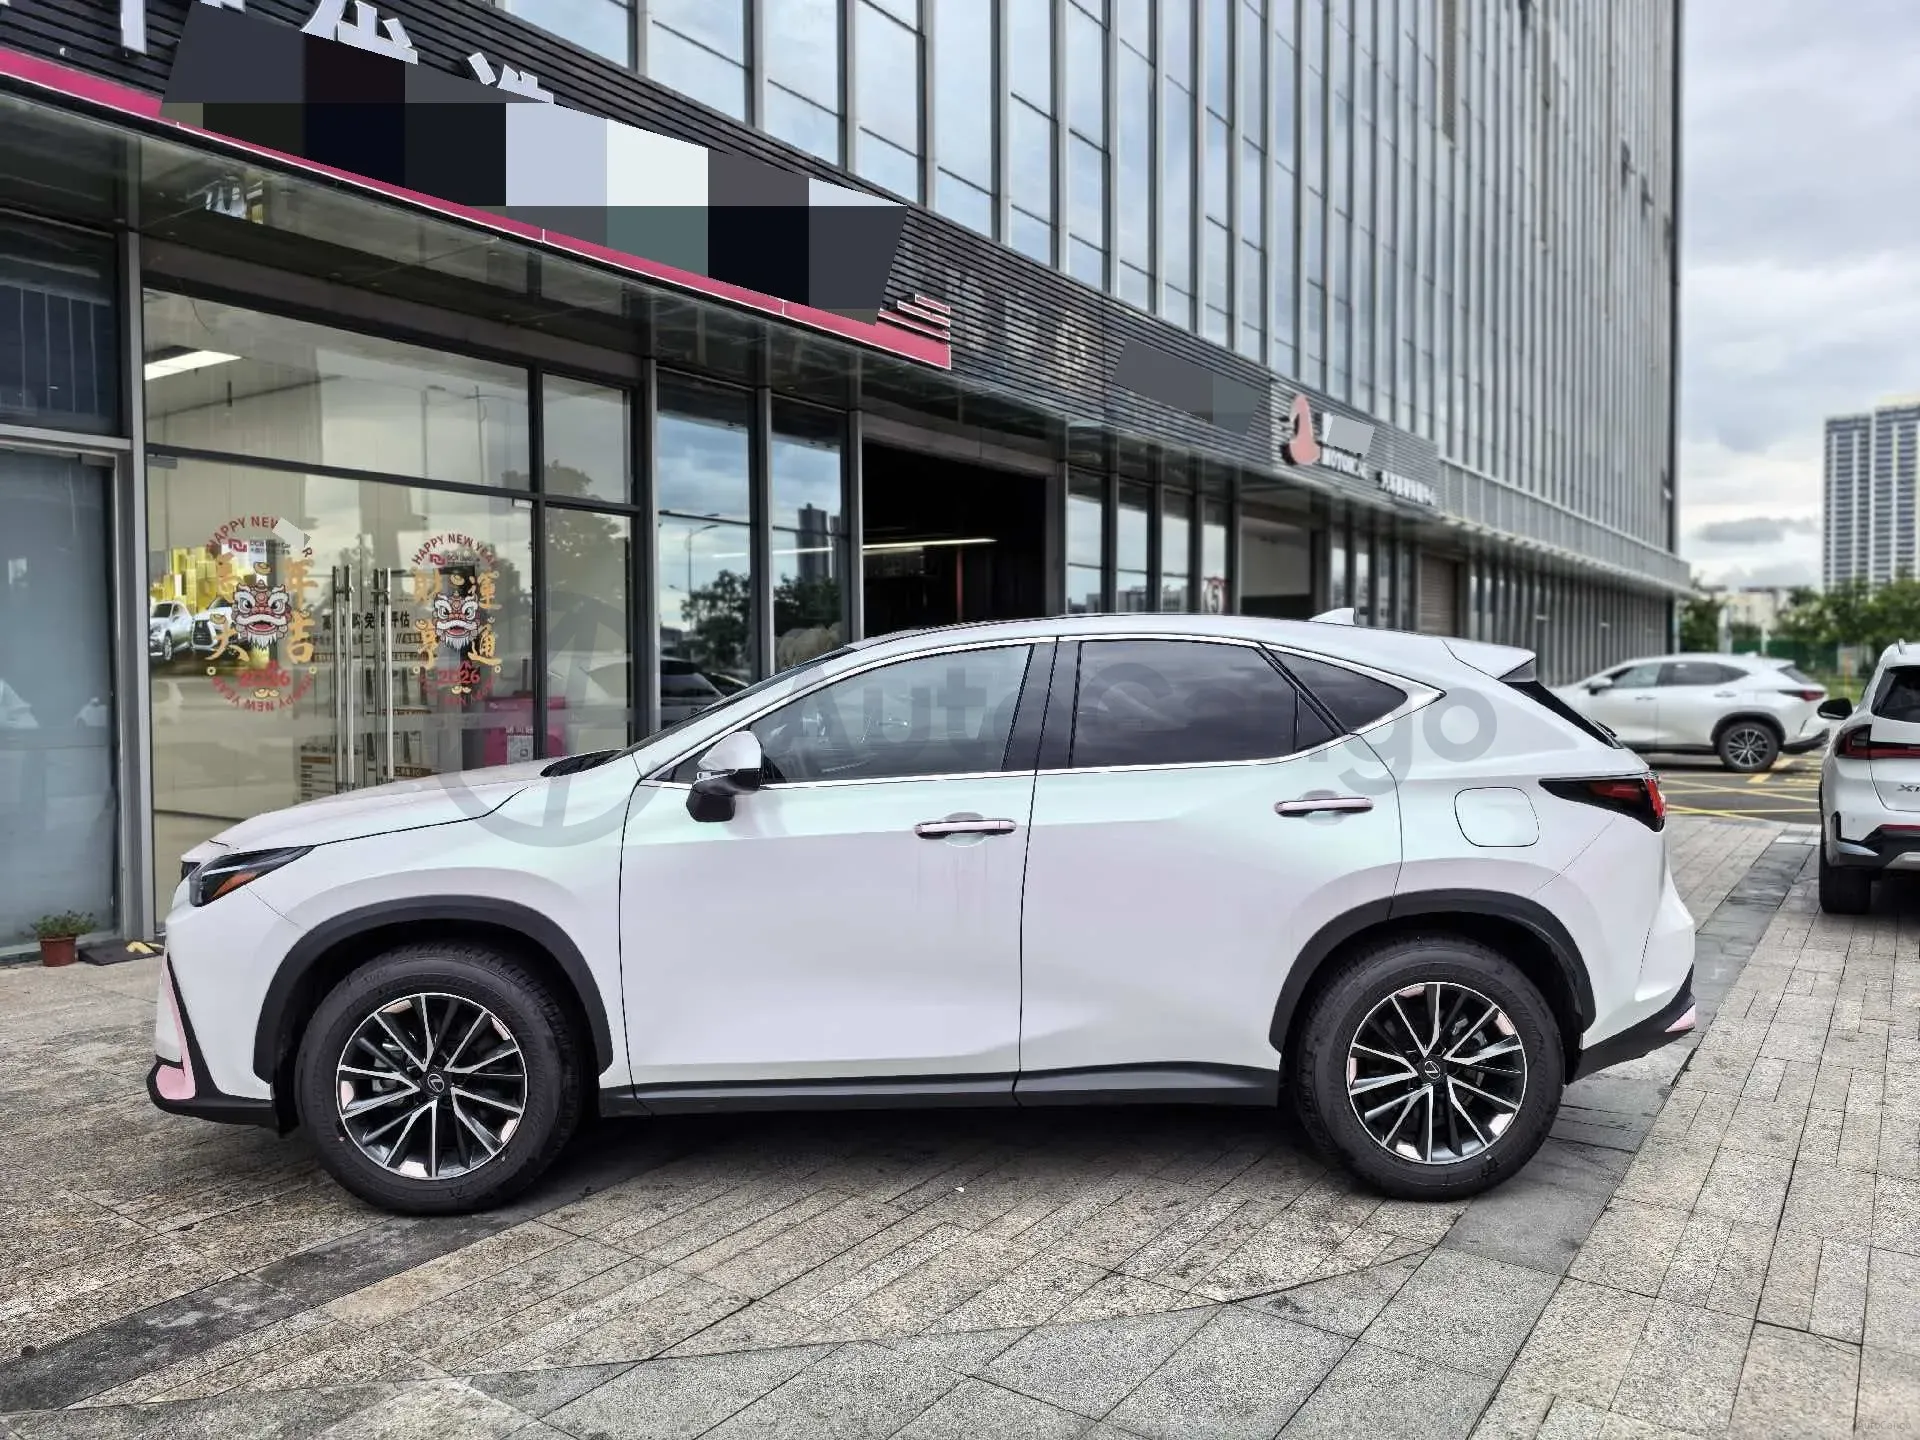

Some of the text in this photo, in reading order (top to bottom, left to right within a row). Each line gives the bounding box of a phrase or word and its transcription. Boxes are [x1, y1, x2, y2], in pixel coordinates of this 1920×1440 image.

[206, 518, 246, 551] HAPPY
[411, 535, 444, 565] HAPPY
[448, 533, 474, 548] NEW
[436, 669, 481, 685] 2026
